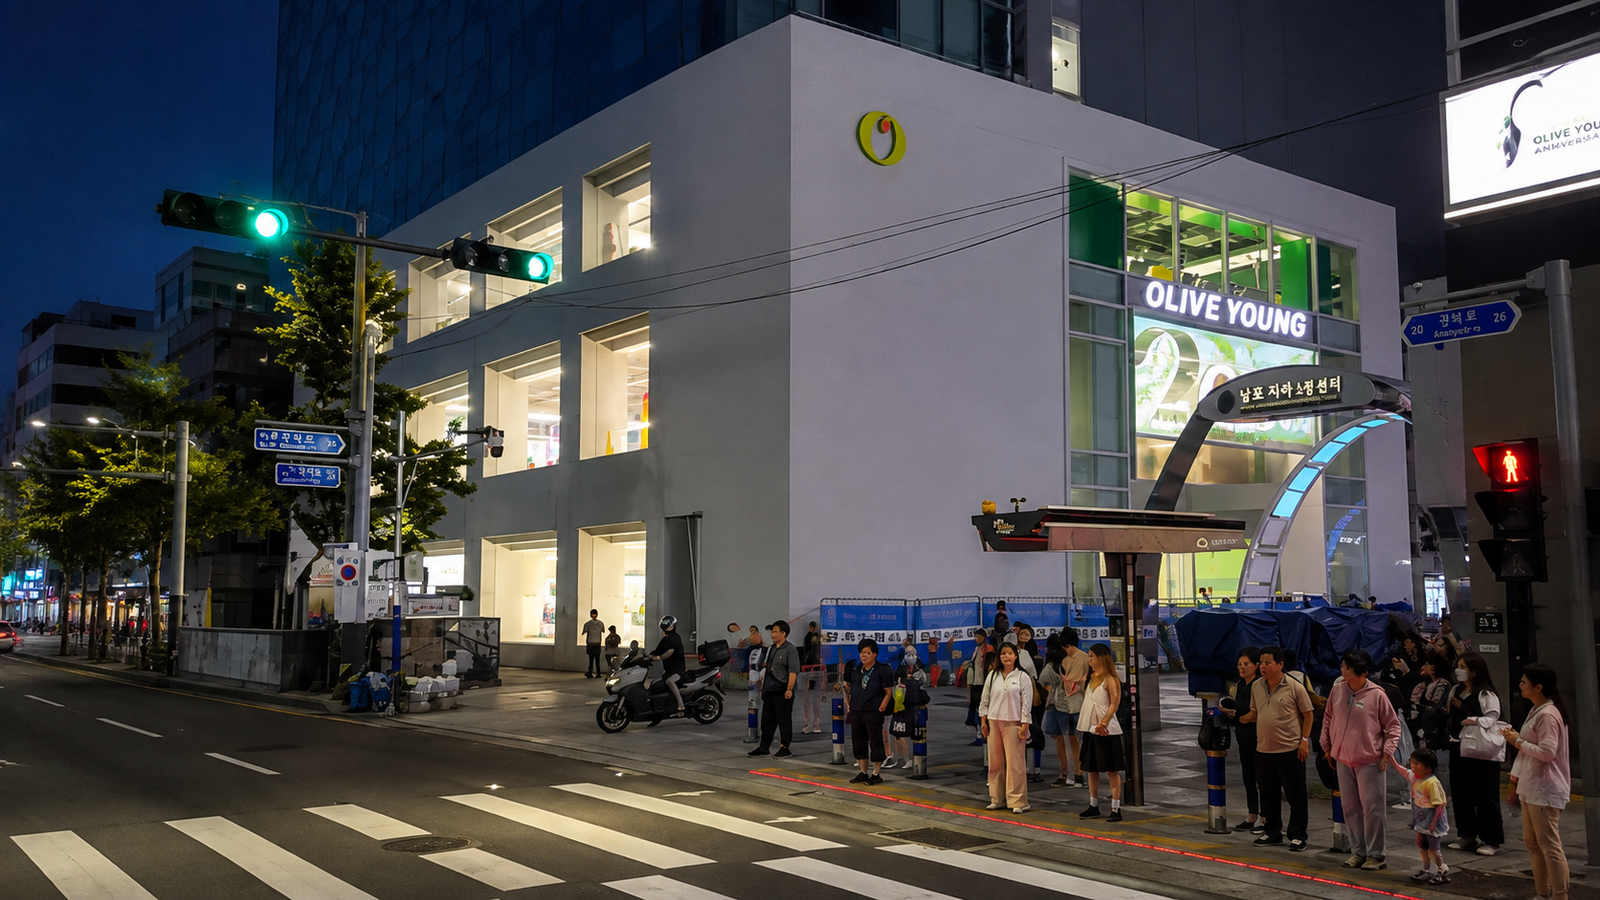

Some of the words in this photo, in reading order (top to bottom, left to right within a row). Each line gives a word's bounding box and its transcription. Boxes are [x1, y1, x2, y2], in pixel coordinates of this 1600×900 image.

[1533, 128, 1570, 144] OLIVE
[1145, 280, 1221, 321] OLIVE
[1227, 297, 1307, 338] YOUNG
[1411, 325, 1424, 335] 20
[1493, 311, 1507, 323] 26
[1239, 386, 1265, 404] 남포
